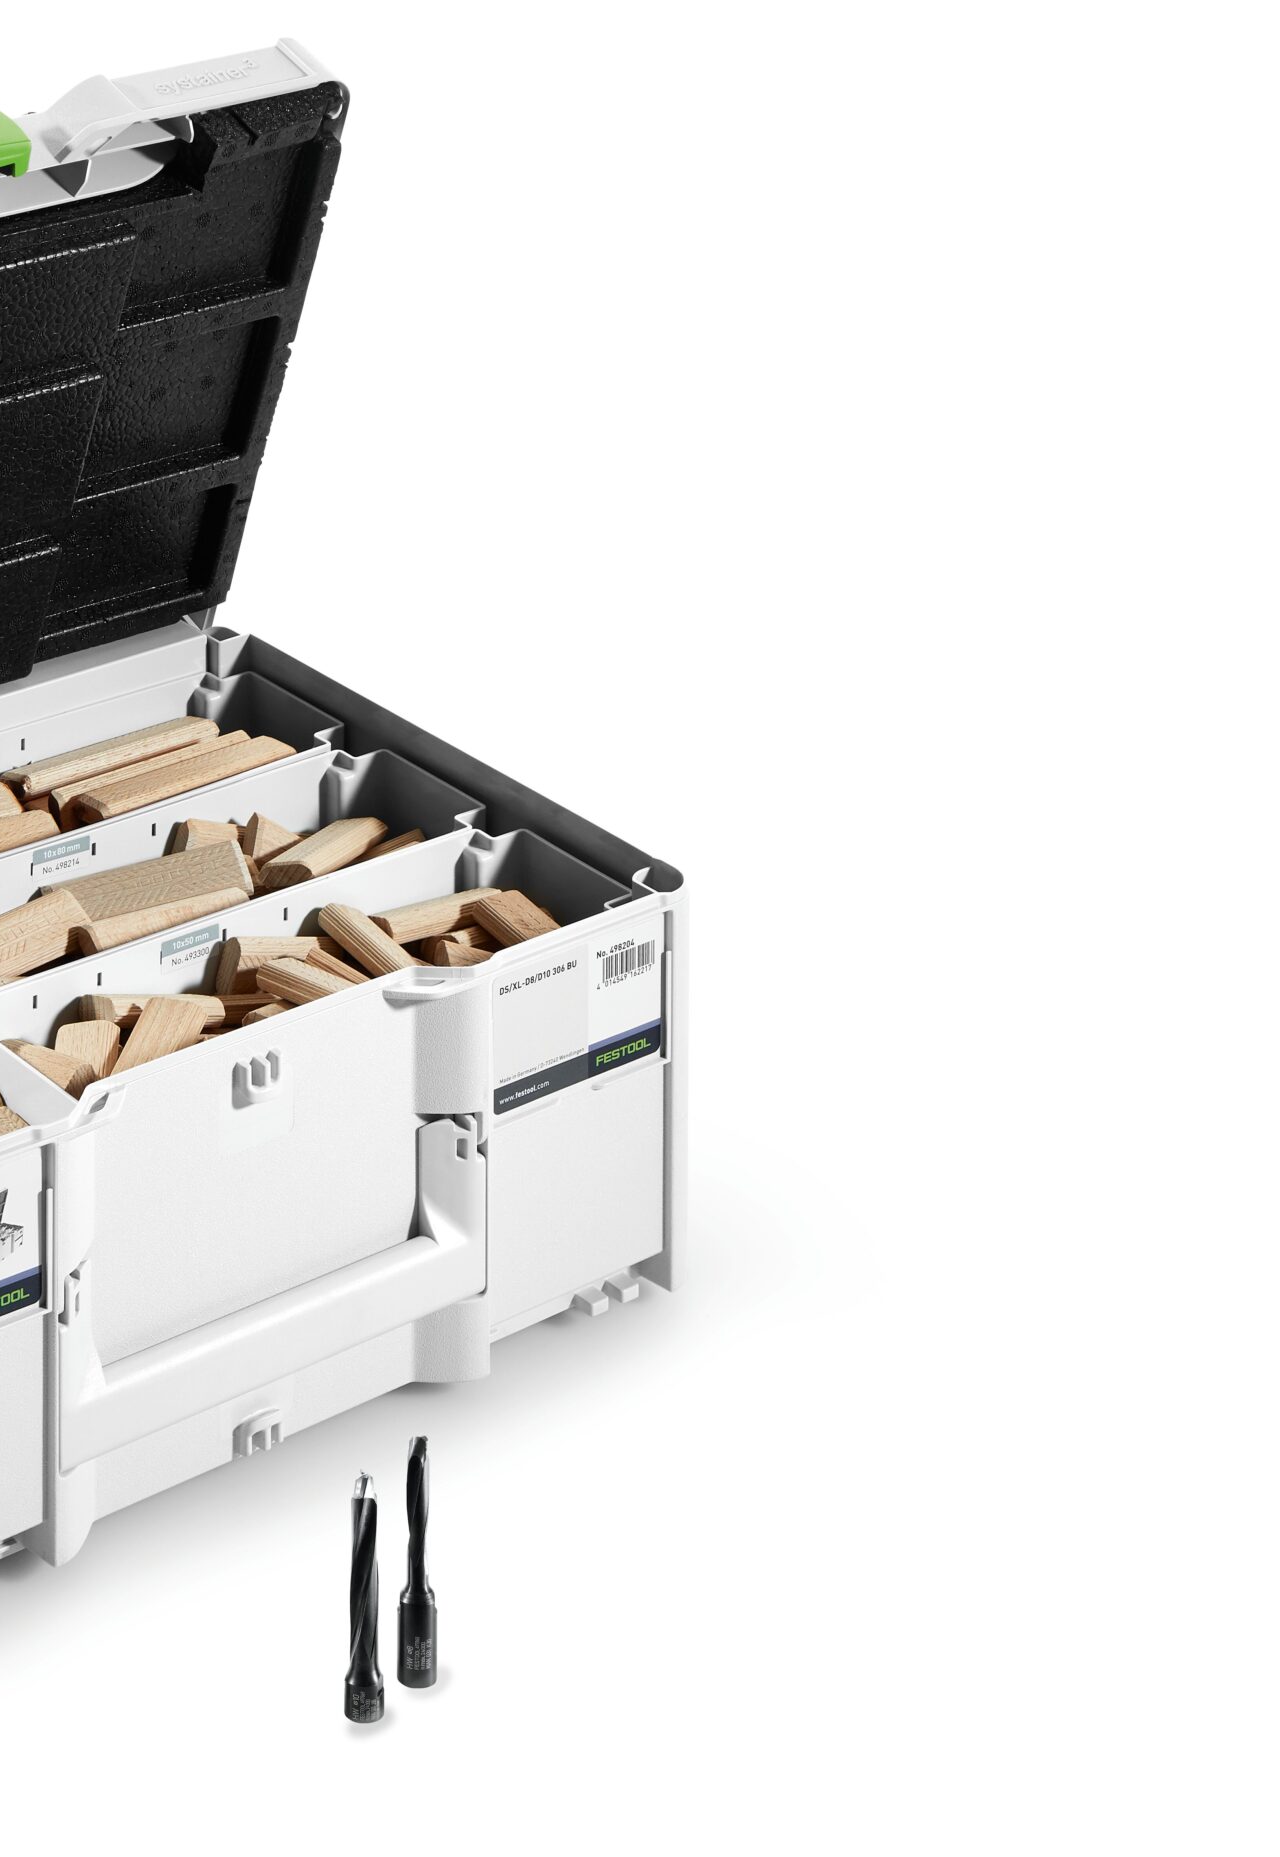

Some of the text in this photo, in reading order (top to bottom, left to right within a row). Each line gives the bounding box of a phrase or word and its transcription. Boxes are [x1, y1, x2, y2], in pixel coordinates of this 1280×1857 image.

[43, 843, 81, 860] 10x80 mm
[42, 858, 80, 875] No. 498214
[172, 931, 209, 950] 10x50 mm
[596, 938, 635, 959] No. 498204
[171, 946, 210, 966] No. 493300
[499, 959, 578, 996] DS/XL-D8/D10 306 BU
[595, 1038, 651, 1067] FESTOOL
[499, 1080, 550, 1104] www.festool.com
